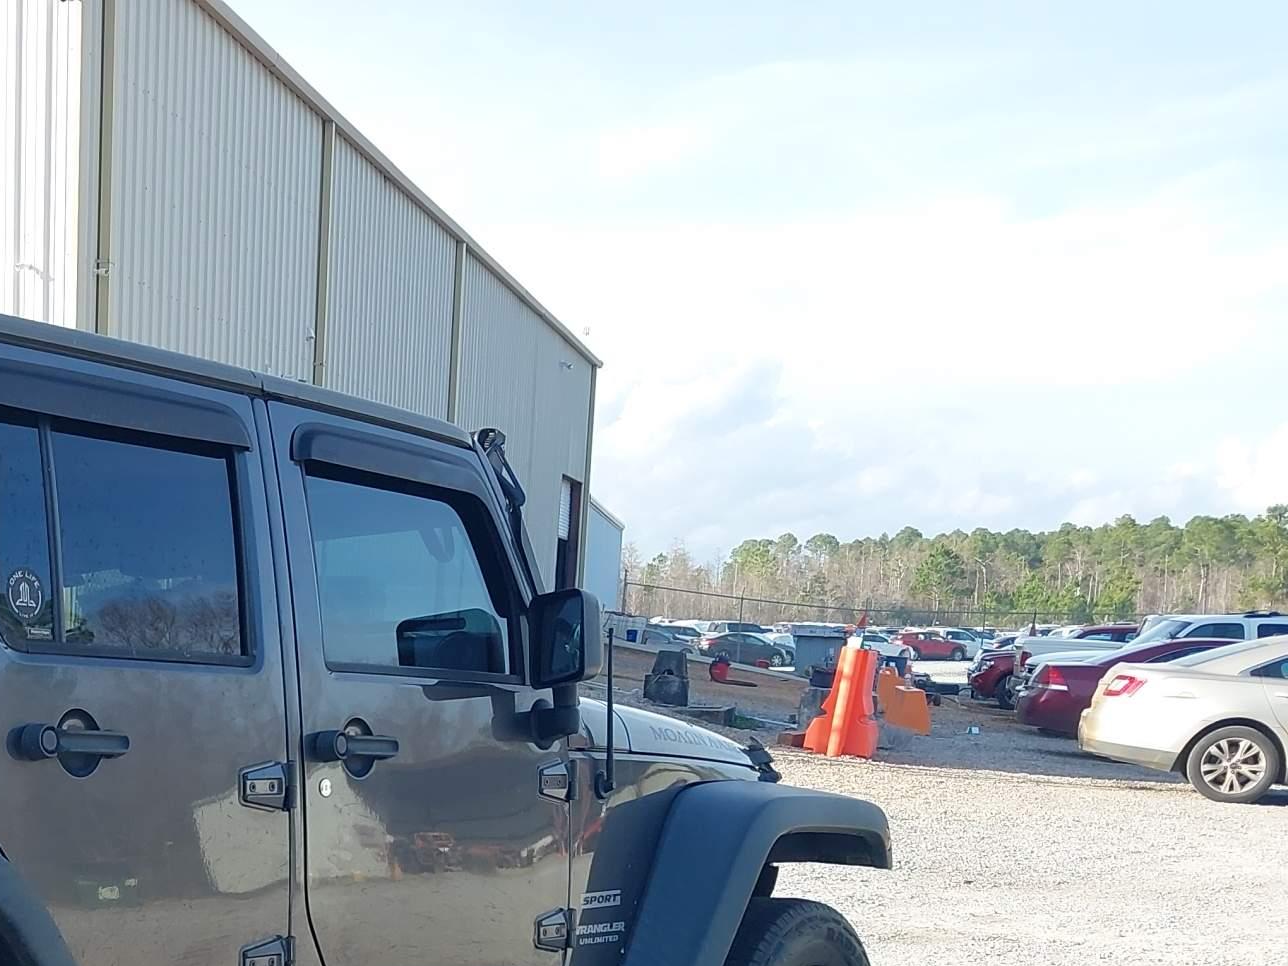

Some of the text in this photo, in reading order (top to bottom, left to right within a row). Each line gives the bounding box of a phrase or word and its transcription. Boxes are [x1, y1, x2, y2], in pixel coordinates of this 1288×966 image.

[9, 570, 40, 589] ONE LIFE
[583, 894, 618, 906] SPORT
[579, 934, 619, 945] UNLIMITED
